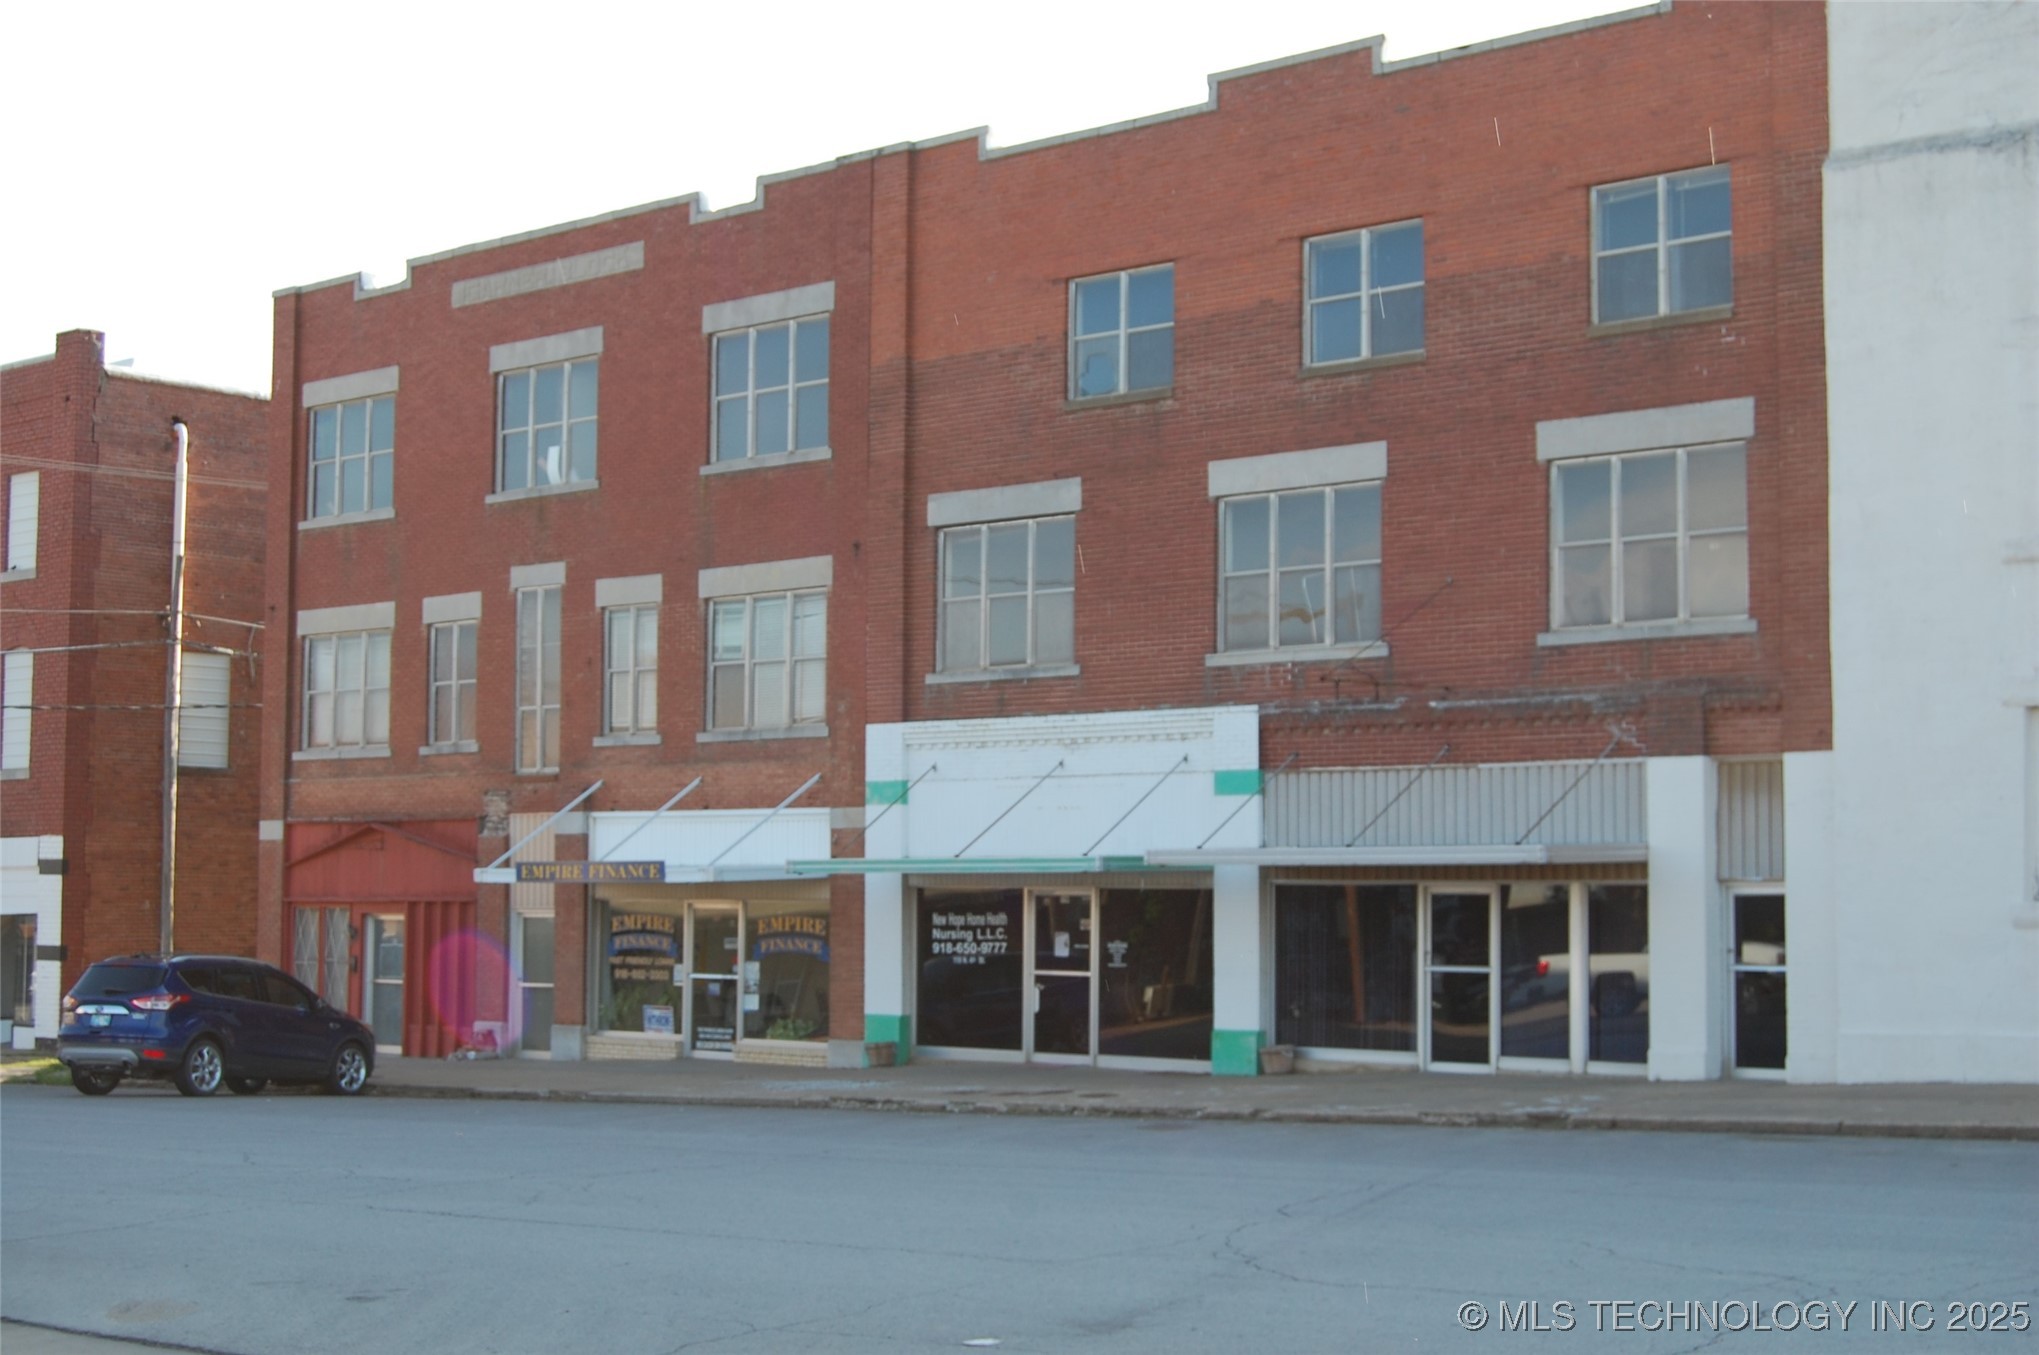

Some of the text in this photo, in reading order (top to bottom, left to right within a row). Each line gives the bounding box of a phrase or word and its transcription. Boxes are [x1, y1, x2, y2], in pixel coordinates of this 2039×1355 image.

[521, 863, 660, 879] EMPIRE FINANCE
[611, 913, 674, 932] EMPIRE
[758, 915, 826, 935] EMPIRE
[932, 912, 946, 925] New
[948, 912, 965, 930] Hope
[986, 912, 1008, 925] Health
[614, 934, 671, 950] FINANCE
[932, 927, 1008, 942] Nursing L.L.C.
[760, 936, 823, 954] FINANCE
[932, 942, 1008, 954] 918-650-9777
